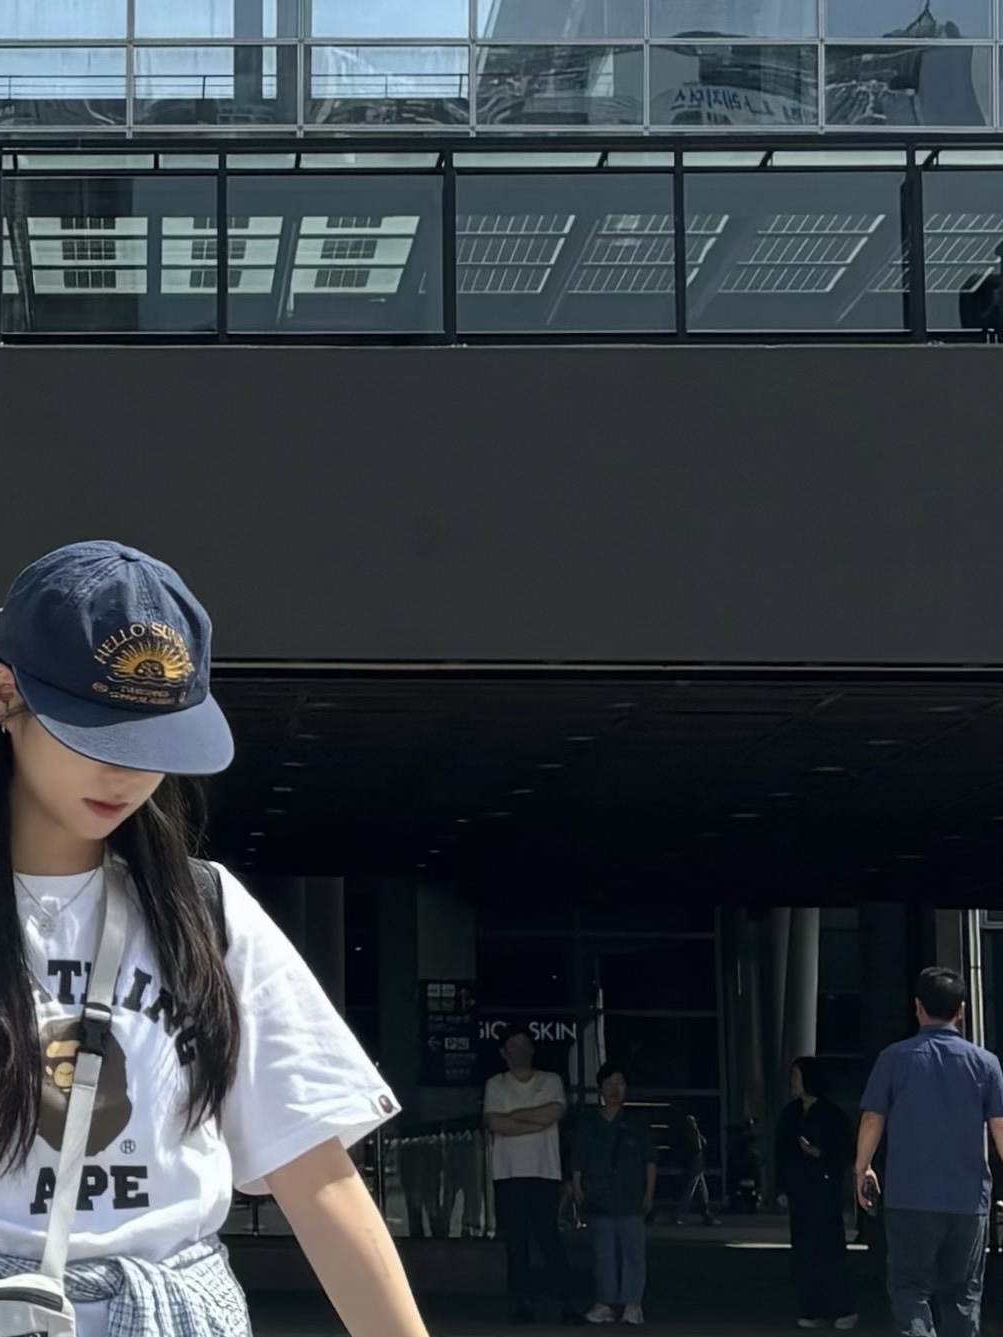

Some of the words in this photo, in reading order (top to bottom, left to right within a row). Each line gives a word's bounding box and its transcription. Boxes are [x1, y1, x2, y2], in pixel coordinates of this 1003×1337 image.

[94, 623, 146, 665] HELLO
[528, 1021, 577, 1042] SKIN
[29, 1164, 150, 1216] APE
